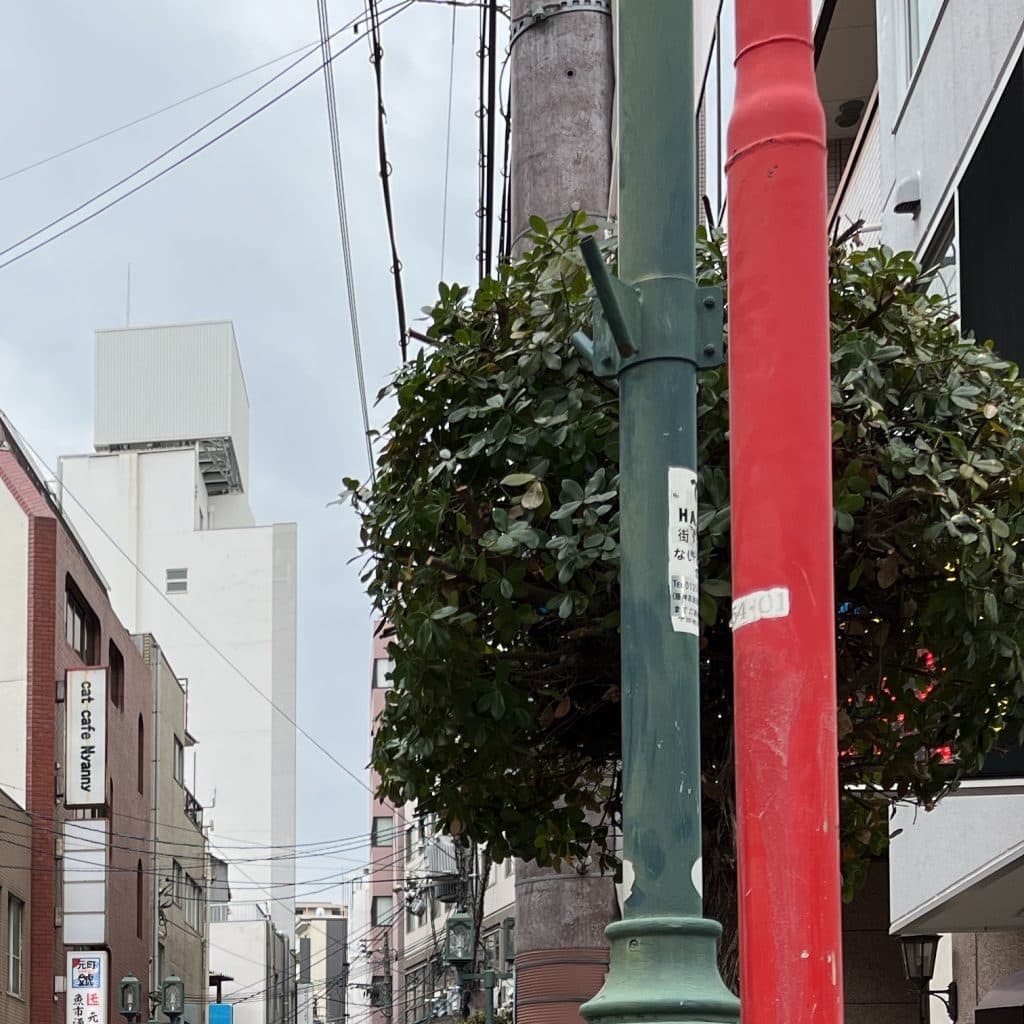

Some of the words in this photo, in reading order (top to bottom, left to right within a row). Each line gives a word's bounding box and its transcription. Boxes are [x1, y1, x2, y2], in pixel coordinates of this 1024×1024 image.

[81, 681, 94, 704] cat
[81, 710, 95, 740] cafe
[81, 745, 95, 792] Nyanny
